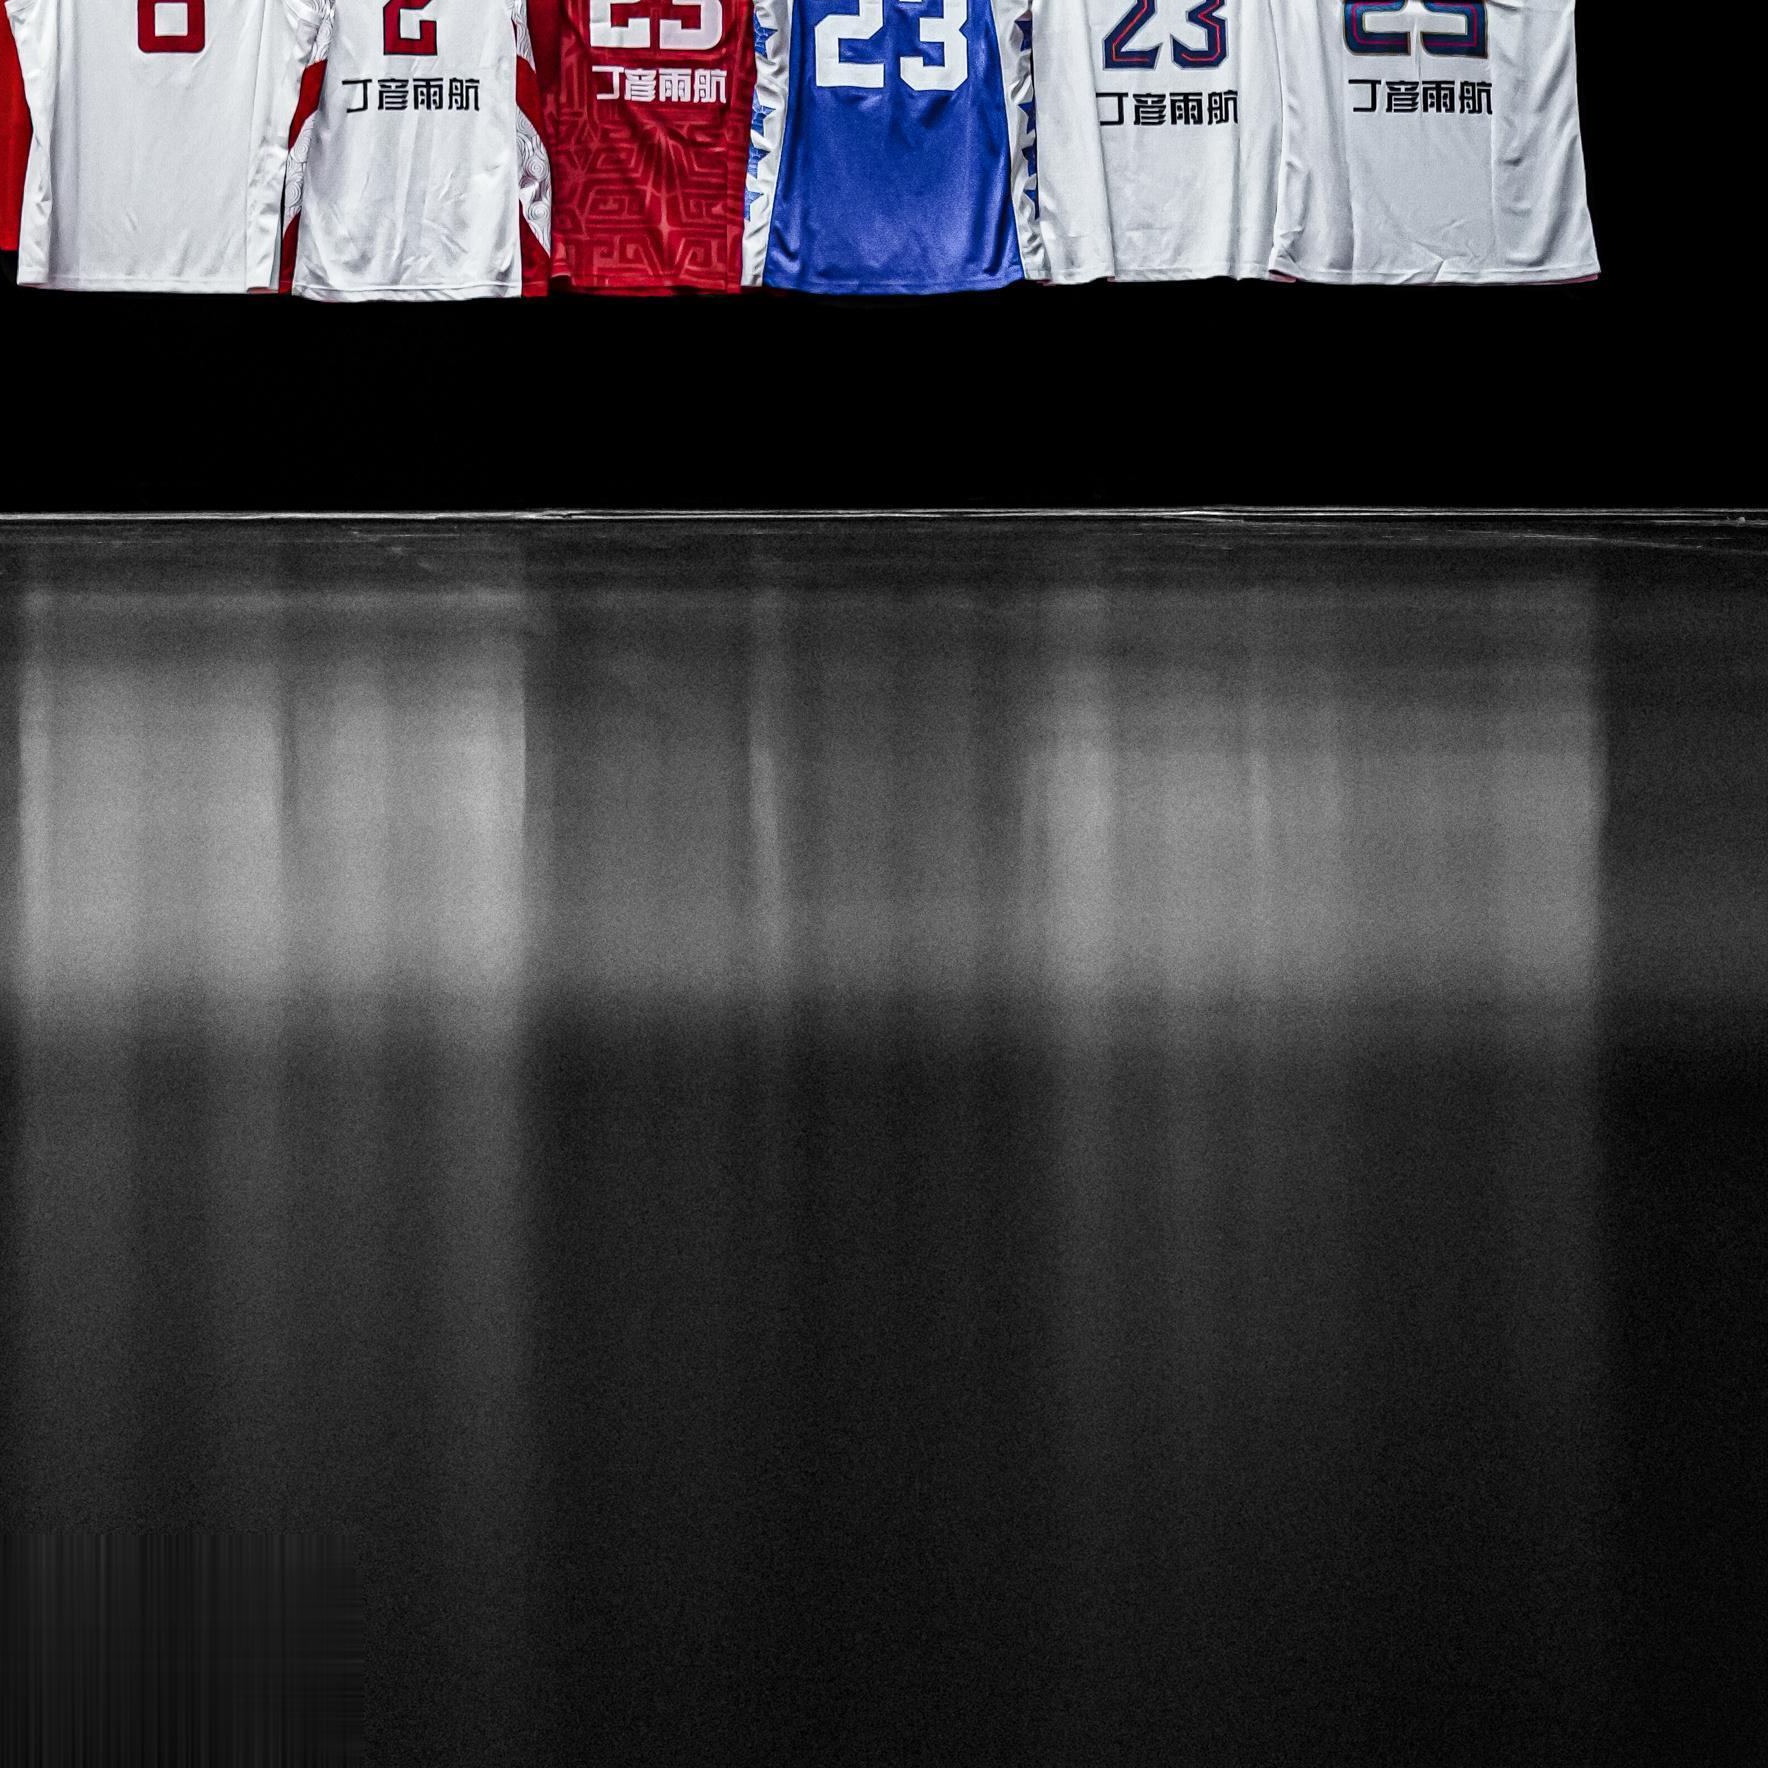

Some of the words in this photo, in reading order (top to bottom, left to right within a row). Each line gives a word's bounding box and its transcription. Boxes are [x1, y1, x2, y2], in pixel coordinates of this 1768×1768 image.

[341, 77, 480, 112] 丁彦雨航
[591, 65, 728, 104] 丁彦雨航
[1348, 78, 1493, 115] 丁彦雨航
[1095, 89, 1238, 126] 丁彦雨航
